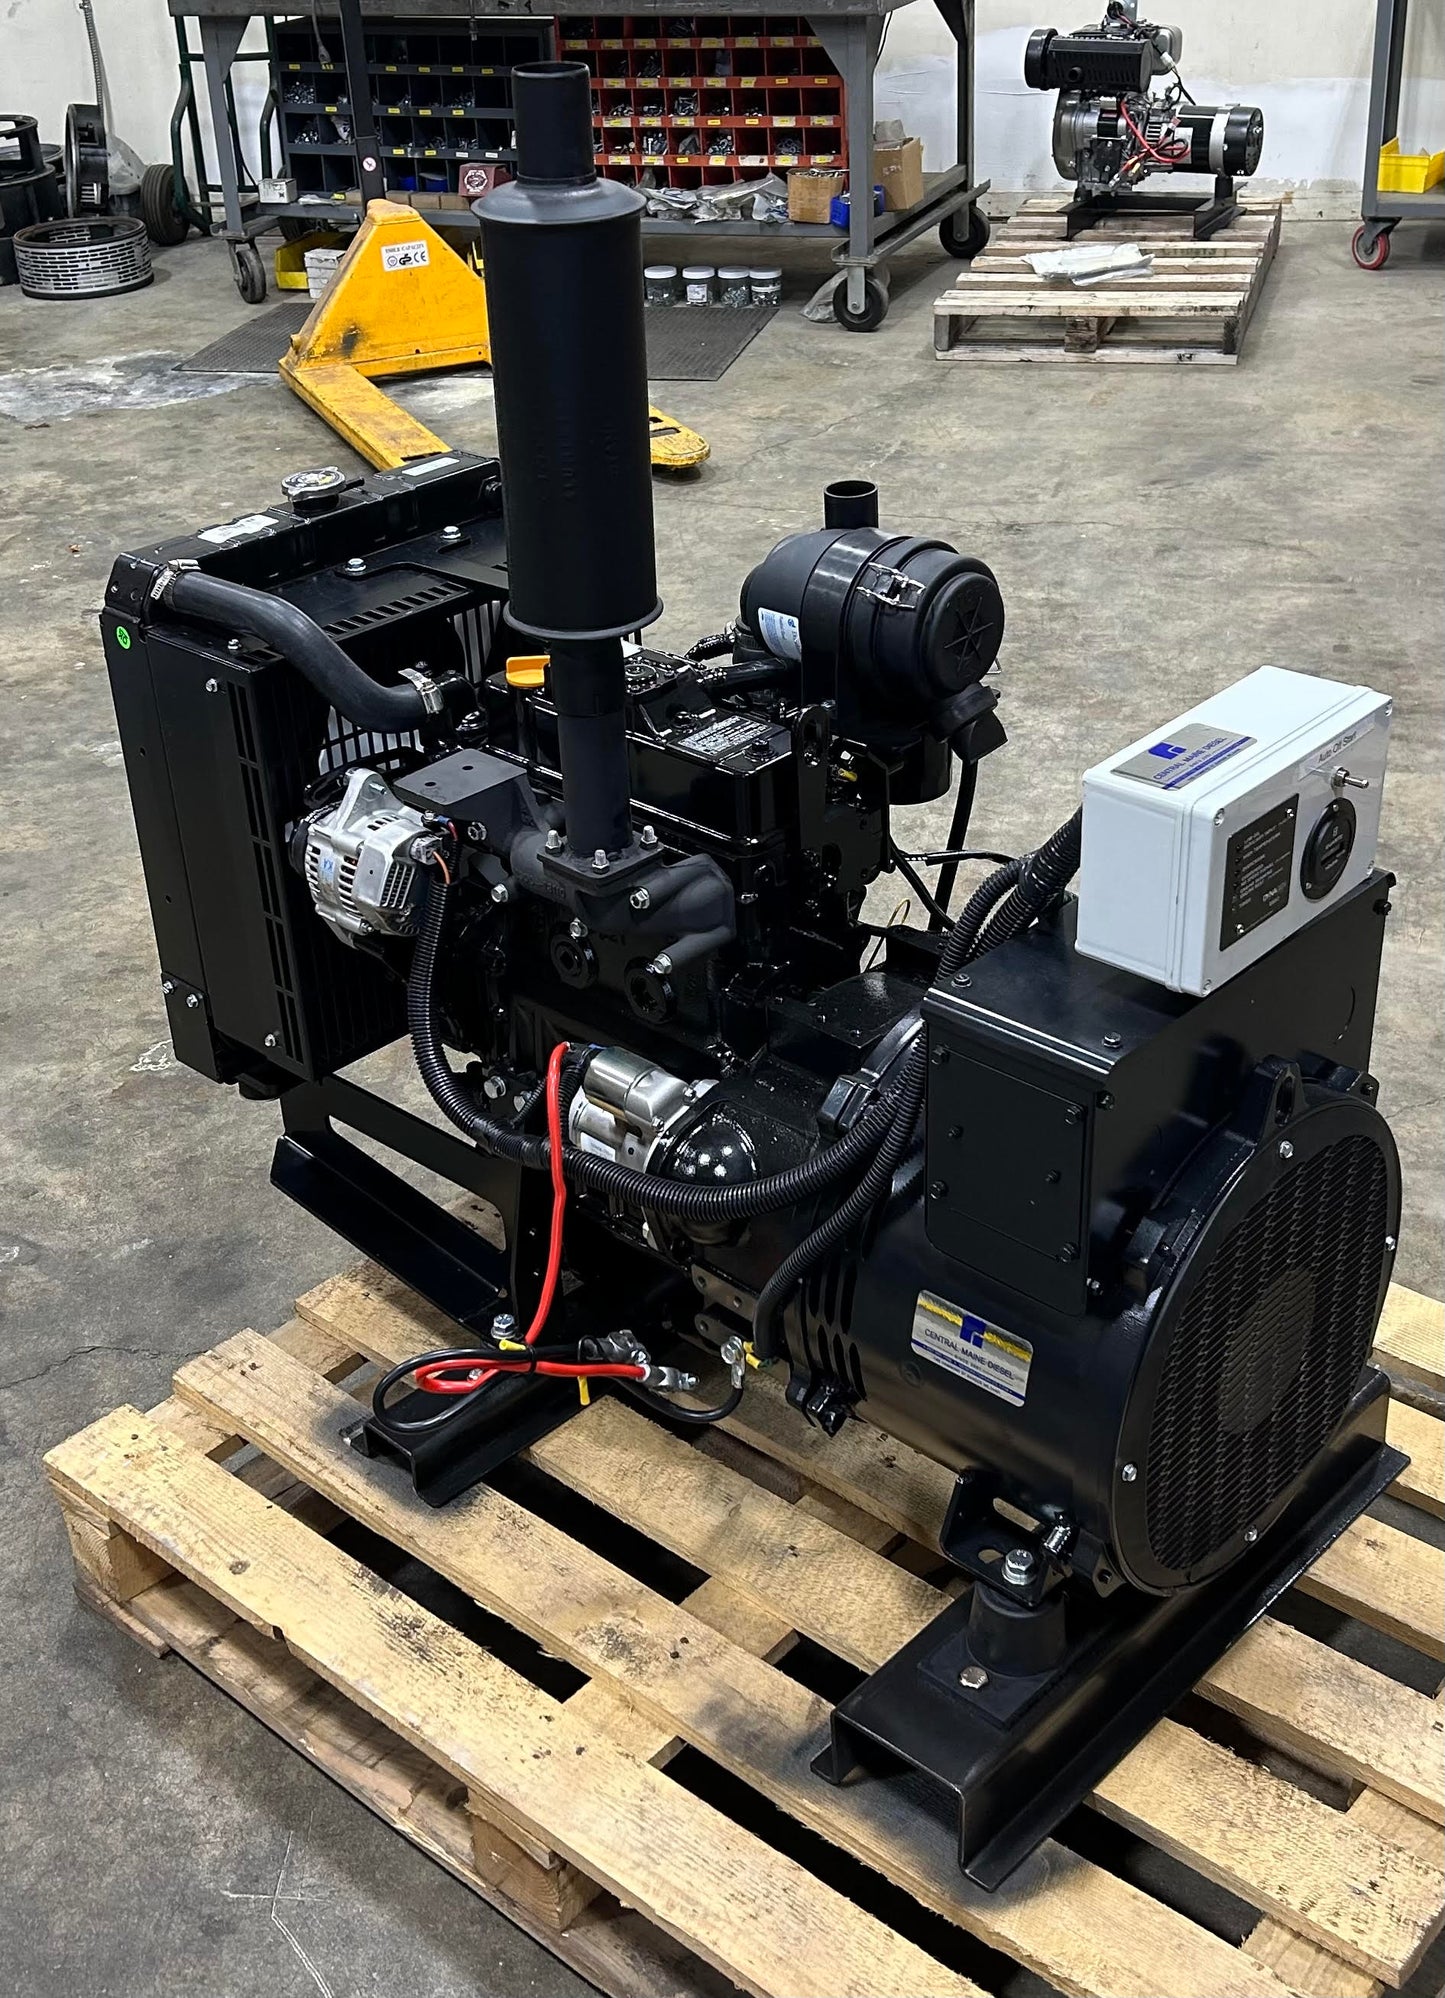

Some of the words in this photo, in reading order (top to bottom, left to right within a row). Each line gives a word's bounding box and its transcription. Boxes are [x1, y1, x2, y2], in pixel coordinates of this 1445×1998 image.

[1153, 760, 1185, 780] CENTRAL
[1181, 747, 1206, 763] MAINE
[1201, 736, 1228, 751] DIESEL
[924, 1327, 960, 1352] CENTRAL
[961, 1347, 987, 1366] MAINE
[987, 1358, 1014, 1380] DIESEL
